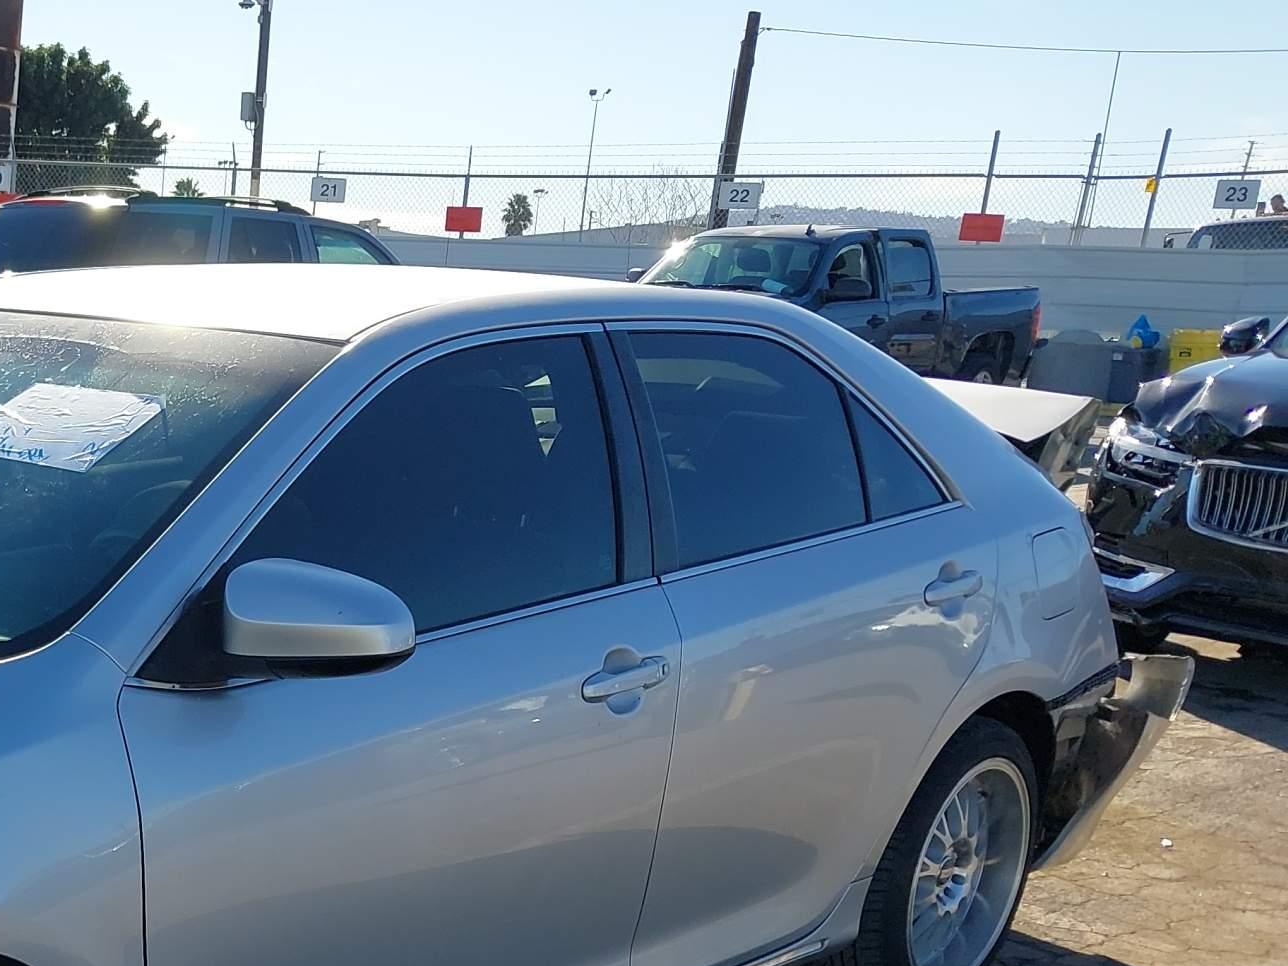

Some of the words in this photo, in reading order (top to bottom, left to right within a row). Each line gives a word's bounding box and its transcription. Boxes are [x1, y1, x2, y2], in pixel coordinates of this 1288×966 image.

[320, 183, 337, 197] 21
[728, 189, 750, 204] 22
[1225, 187, 1249, 202] 23
